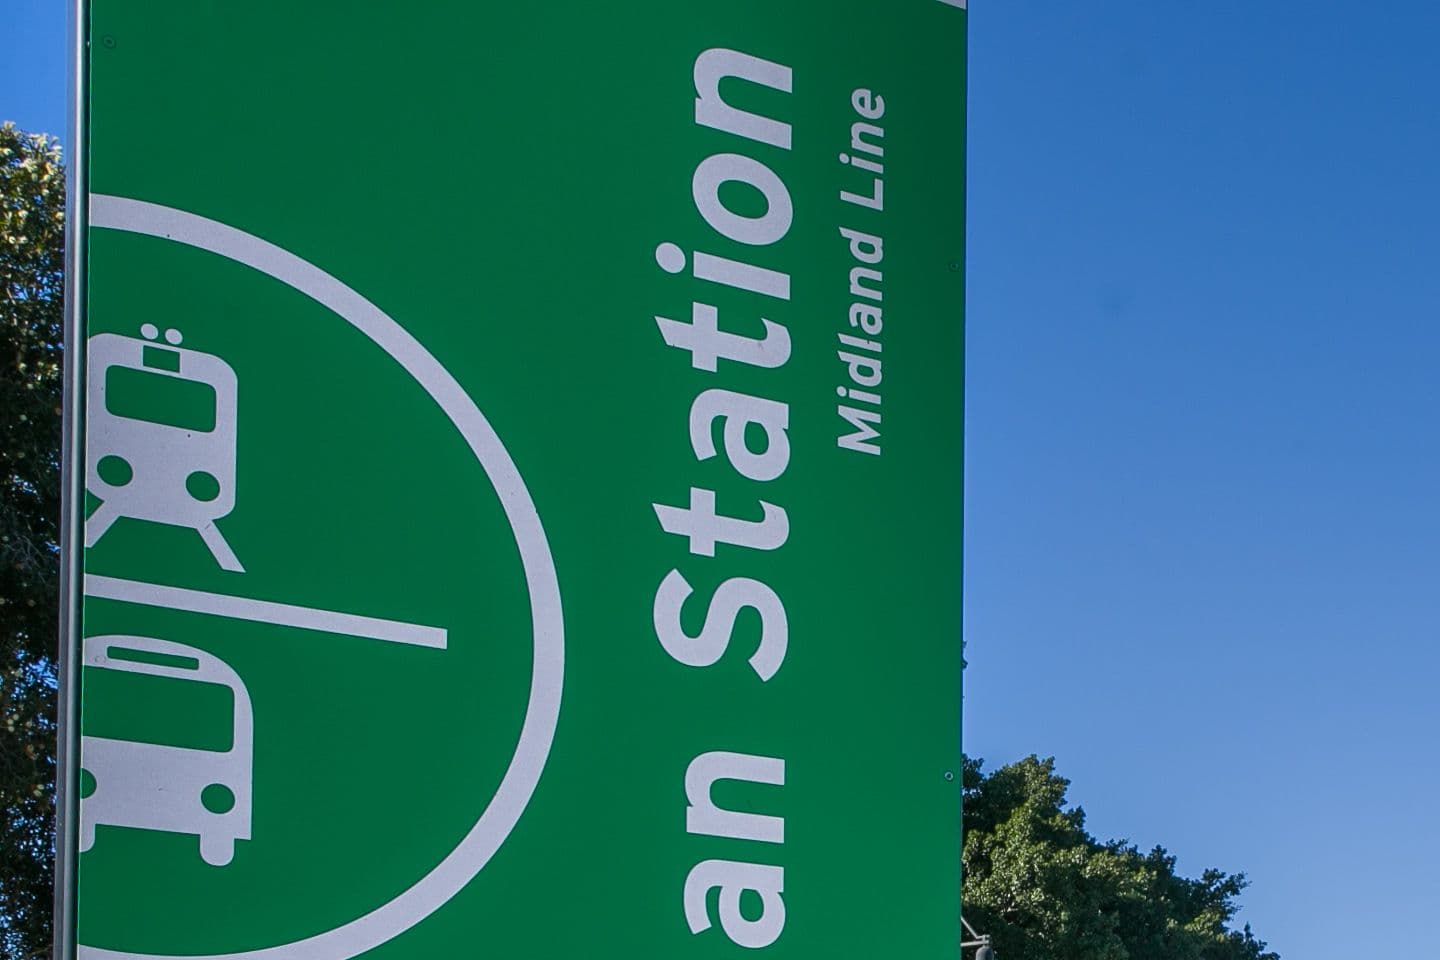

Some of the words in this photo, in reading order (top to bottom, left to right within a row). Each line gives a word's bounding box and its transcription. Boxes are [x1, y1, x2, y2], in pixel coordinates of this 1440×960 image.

[839, 87, 886, 211] Line
[653, 49, 792, 681] Station
[837, 226, 883, 456] Midland
